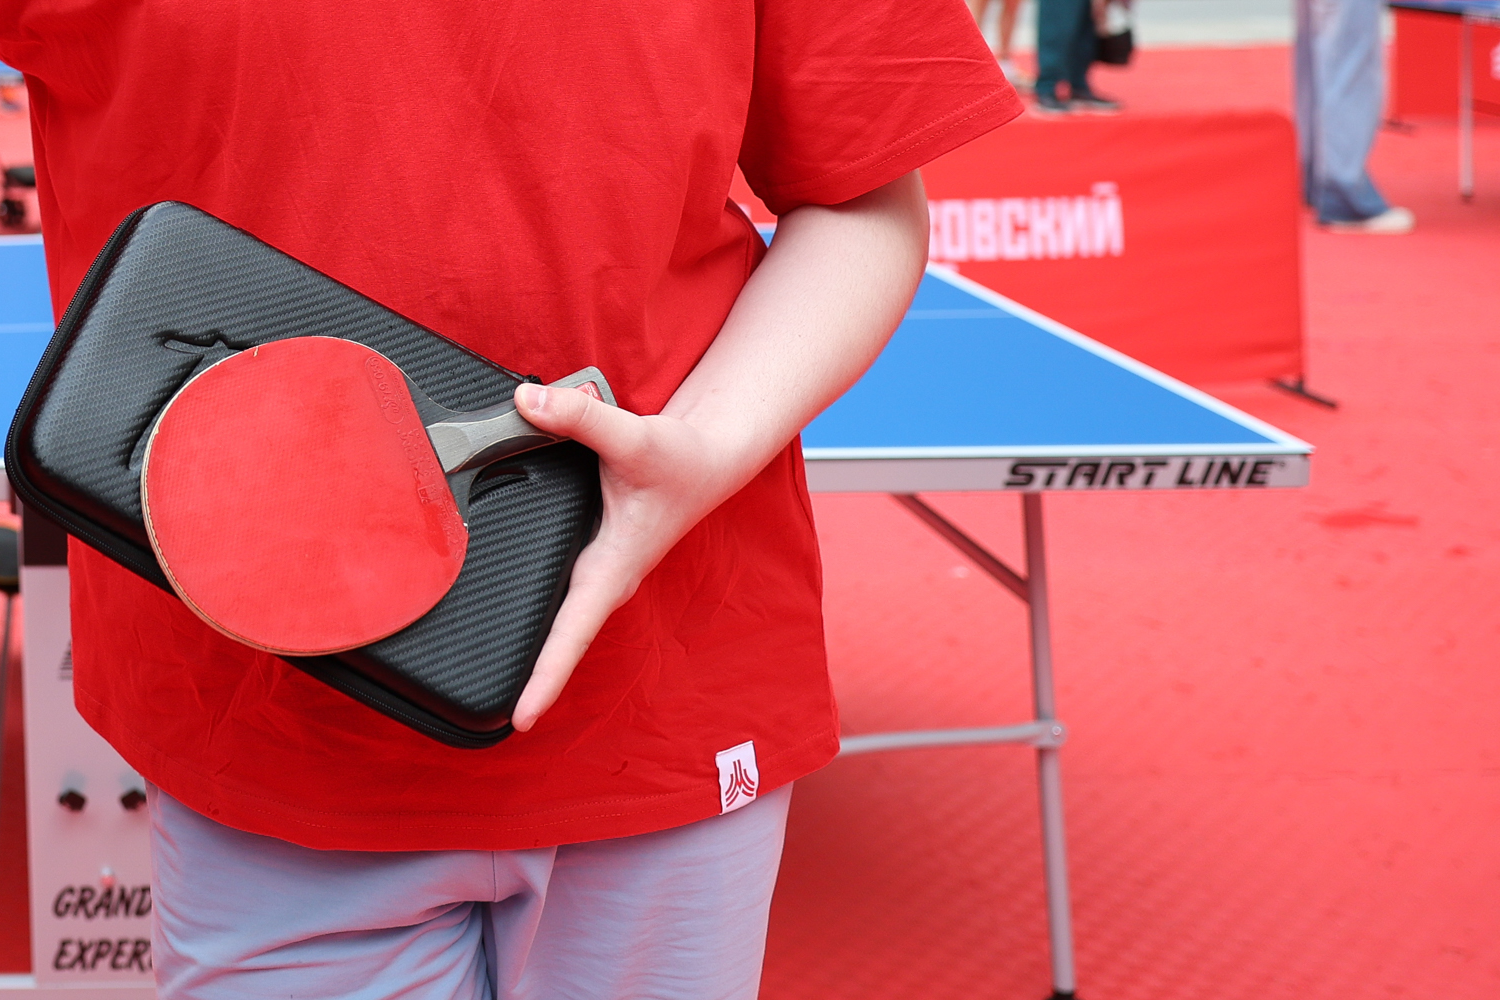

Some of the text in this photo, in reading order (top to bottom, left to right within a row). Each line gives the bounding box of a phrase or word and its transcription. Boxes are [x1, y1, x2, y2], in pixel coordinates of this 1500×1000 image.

[1004, 459, 1276, 488] START LINE
[53, 884, 152, 919] GRAND
